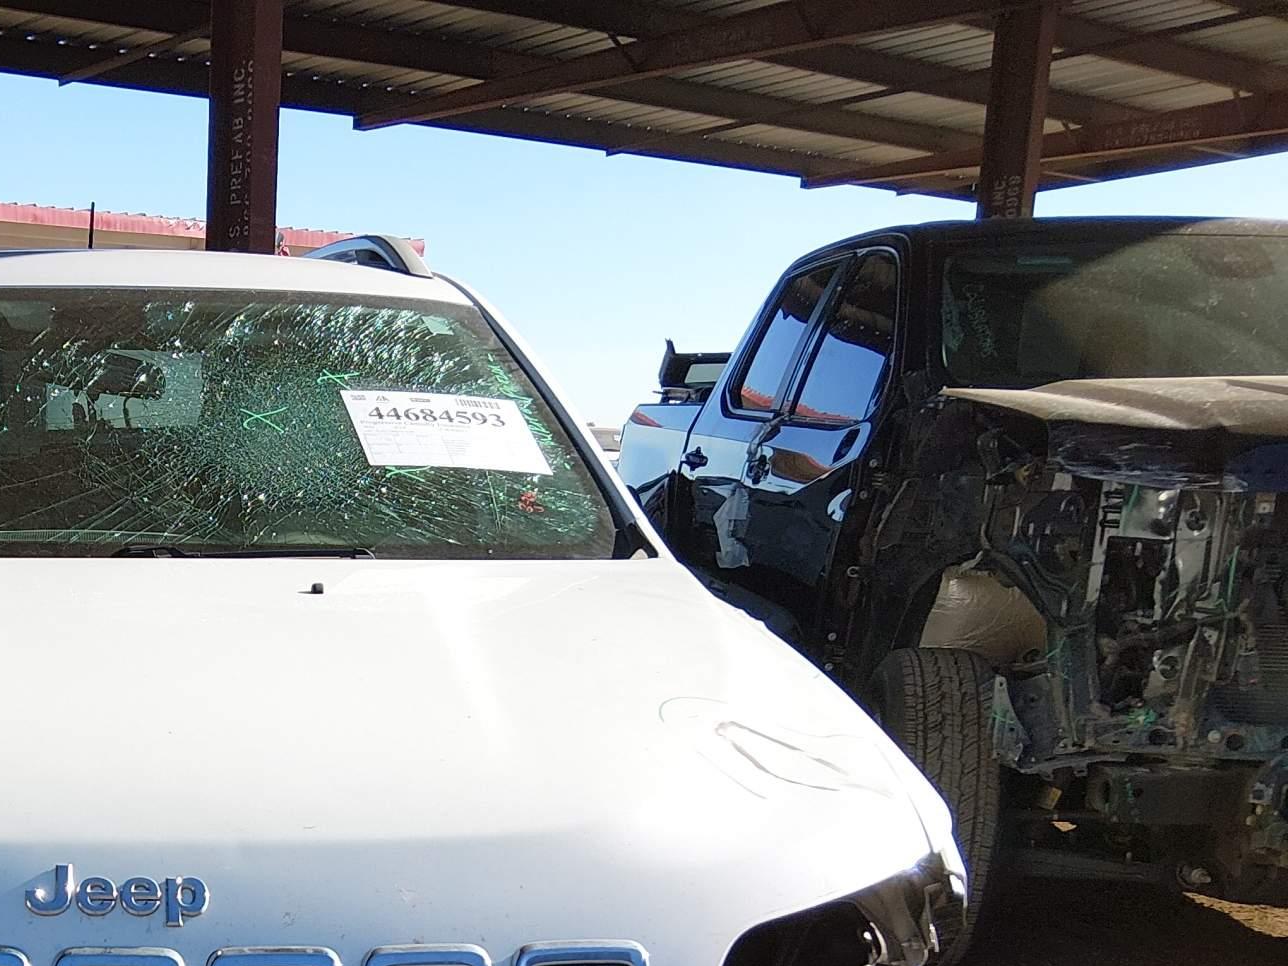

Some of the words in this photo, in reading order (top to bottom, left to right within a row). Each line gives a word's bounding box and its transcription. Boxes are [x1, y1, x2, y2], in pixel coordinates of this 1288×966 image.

[233, 60, 246, 104] INC.
[230, 117, 243, 205] PREFAB
[368, 405, 506, 428] 44684593
[25, 863, 210, 927] Jeep
